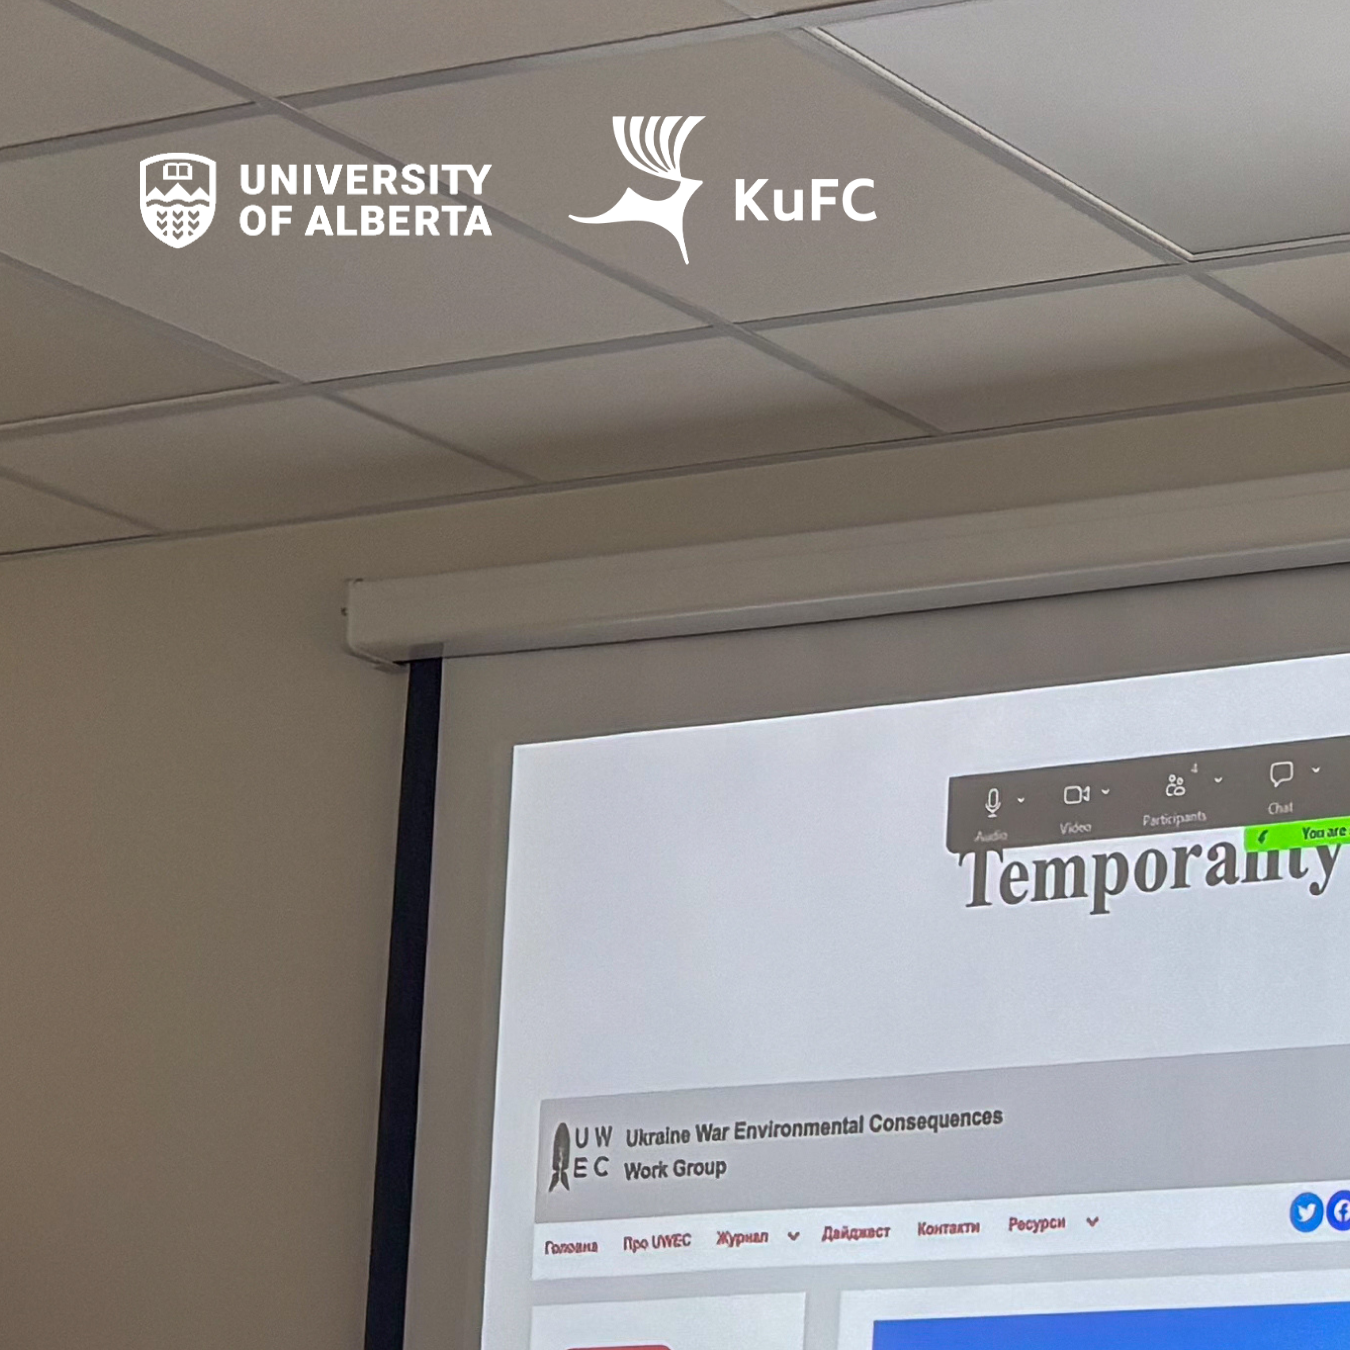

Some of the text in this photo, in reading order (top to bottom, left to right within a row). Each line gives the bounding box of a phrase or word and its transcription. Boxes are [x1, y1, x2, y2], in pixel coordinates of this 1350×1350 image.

[1267, 800, 1294, 815] Chat
[1060, 819, 1092, 835] Video
[1142, 808, 1207, 829] Participants
[974, 826, 1008, 843] Audio
[1303, 827, 1324, 839] You
[1327, 826, 1346, 837] are
[625, 1107, 1003, 1147] Ukraine War Environmental Consequences
[624, 1158, 728, 1181] Work Group
[821, 1225, 891, 1244] Дайджест
[917, 1220, 980, 1237] Контакти
[1008, 1215, 1066, 1235] Ресурси
[623, 1232, 692, 1254] Про UWEC
[716, 1230, 769, 1249] Журнал
